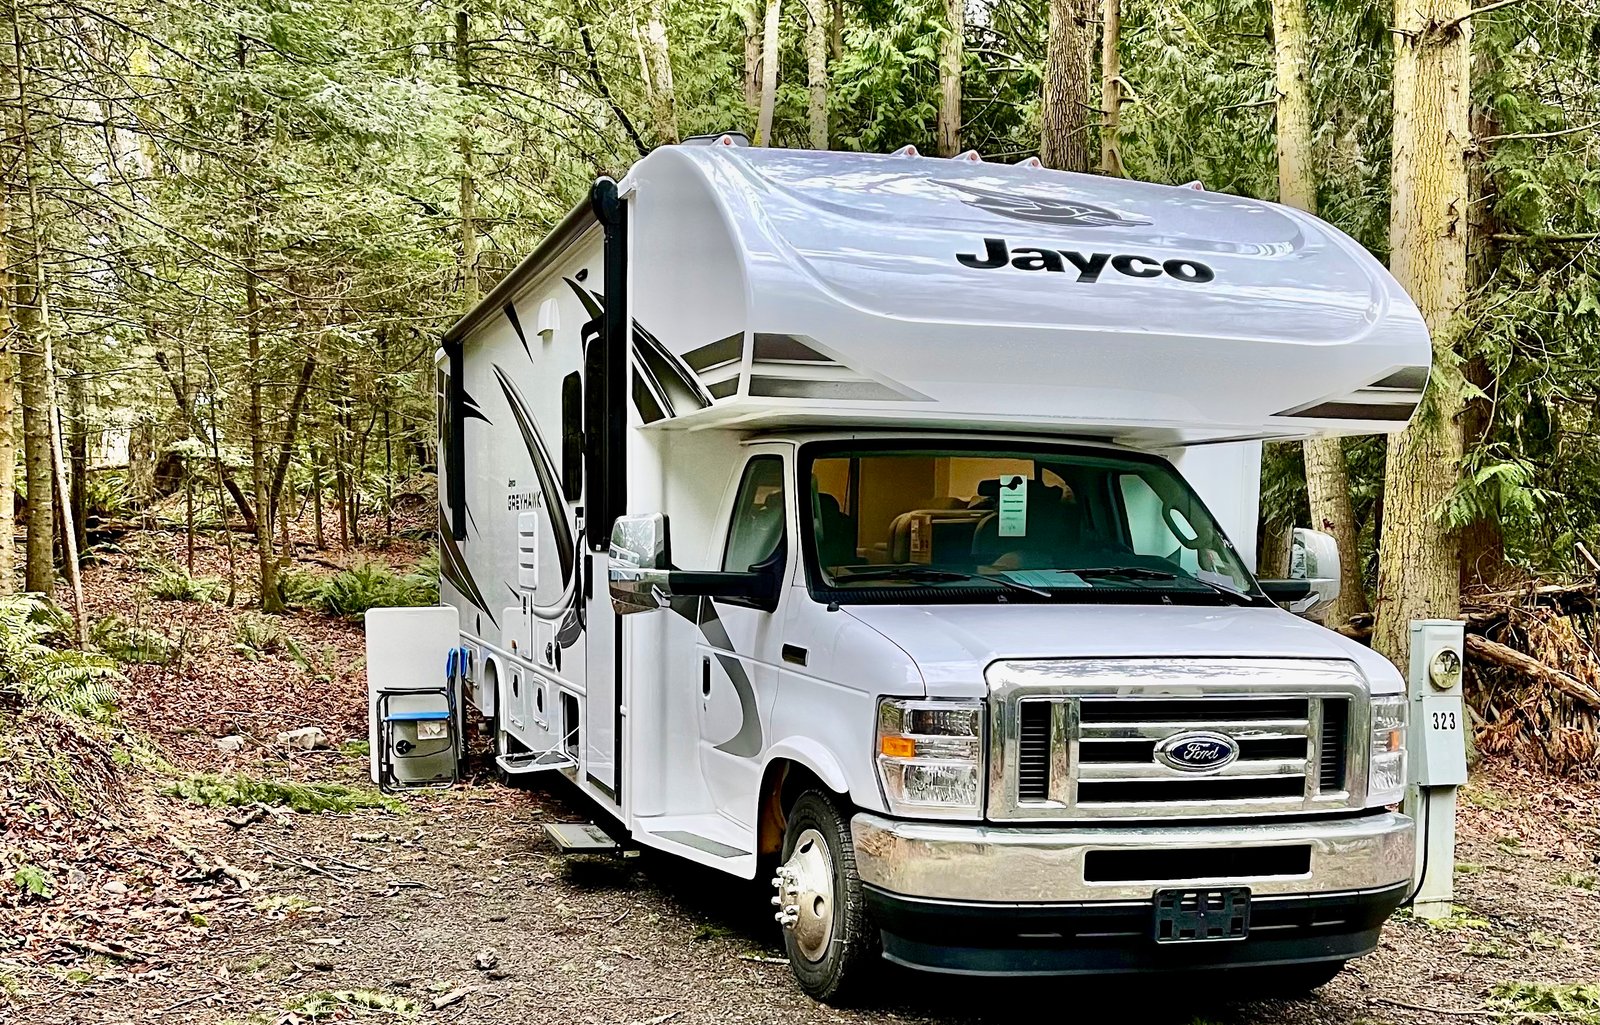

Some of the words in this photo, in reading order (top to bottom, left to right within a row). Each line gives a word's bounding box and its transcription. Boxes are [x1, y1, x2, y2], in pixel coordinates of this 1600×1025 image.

[956, 238, 1215, 283] Jayco
[508, 491, 542, 511] GREYHAWK
[1432, 712, 1456, 730] 323
[1184, 743, 1219, 760] Ford
